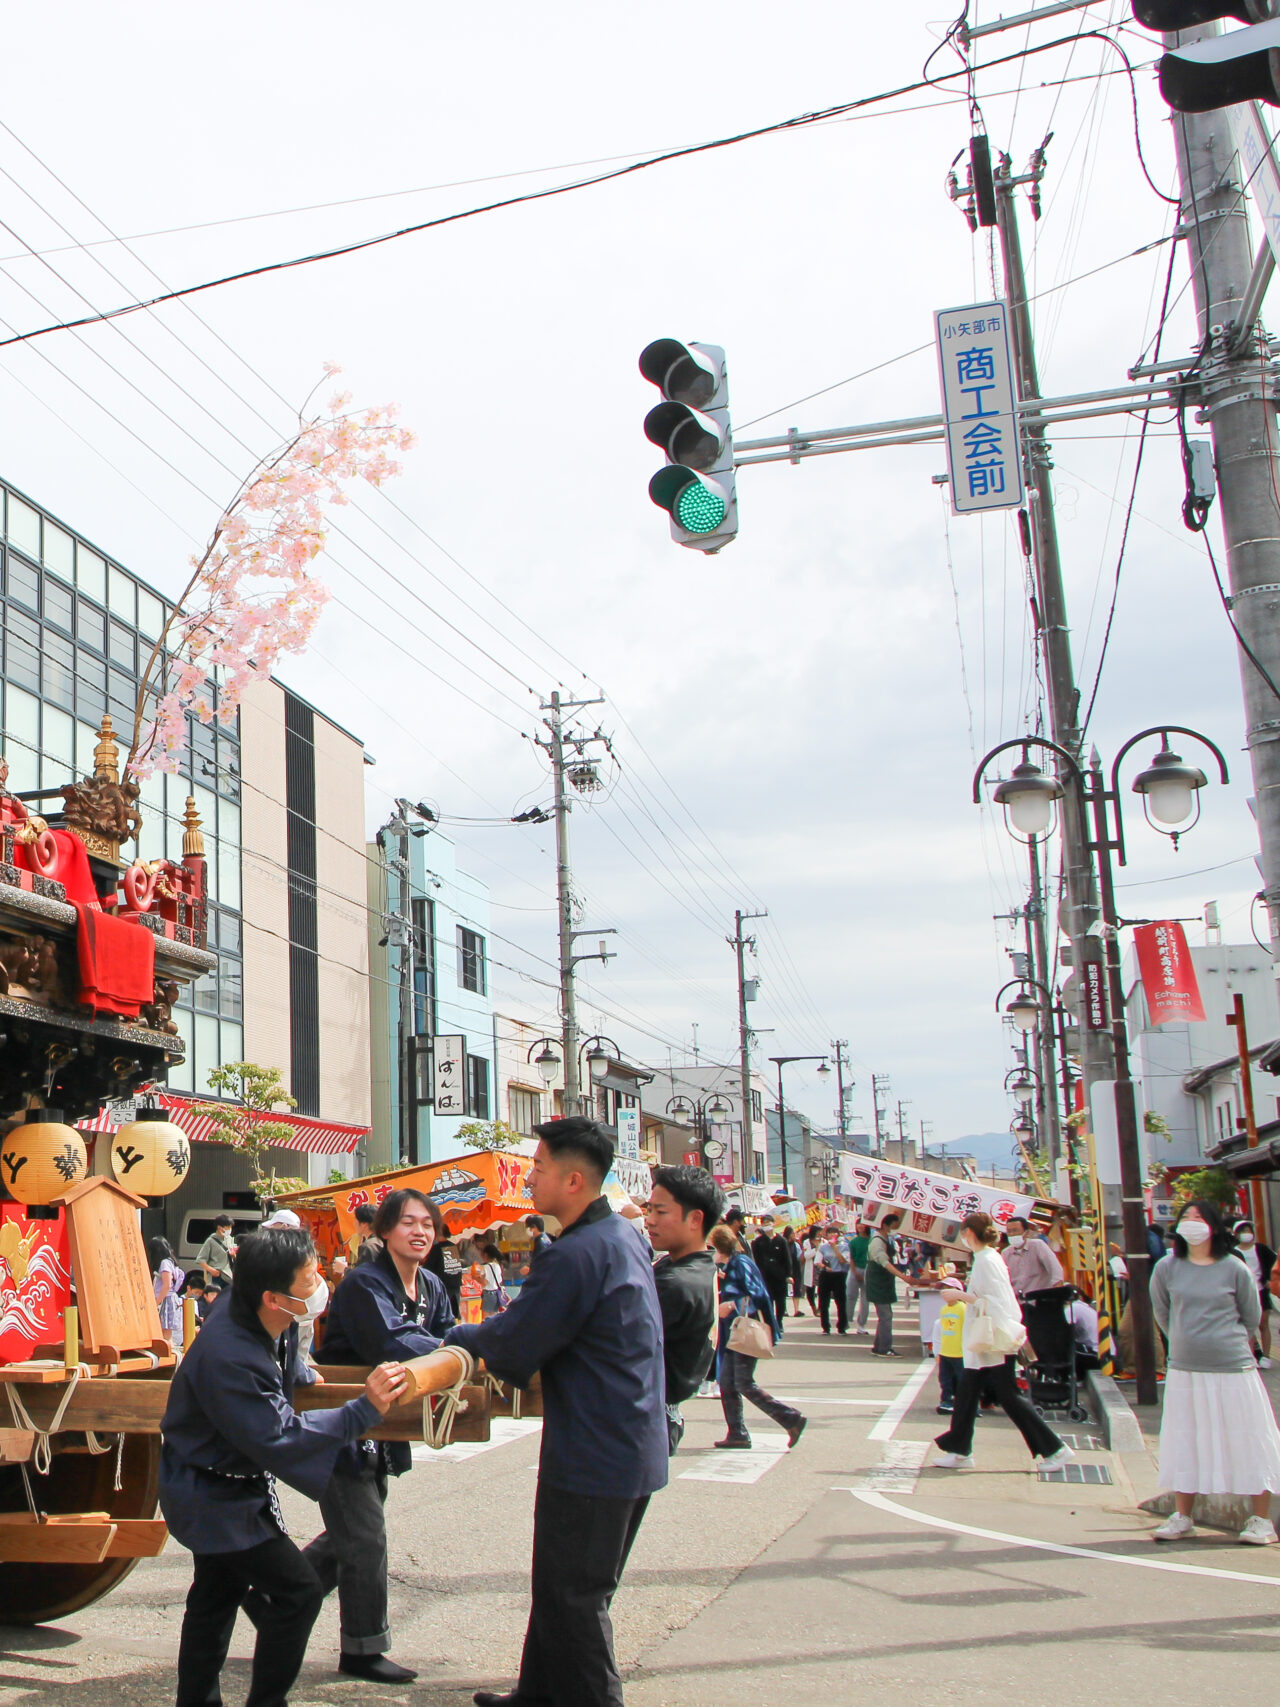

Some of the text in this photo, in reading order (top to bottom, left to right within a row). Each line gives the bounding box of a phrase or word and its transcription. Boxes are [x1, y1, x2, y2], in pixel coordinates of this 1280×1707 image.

[943, 317, 1002, 339] 小矢部市
[955, 346, 1006, 498] 商工会前
[1156, 1000, 1192, 1008] machi
